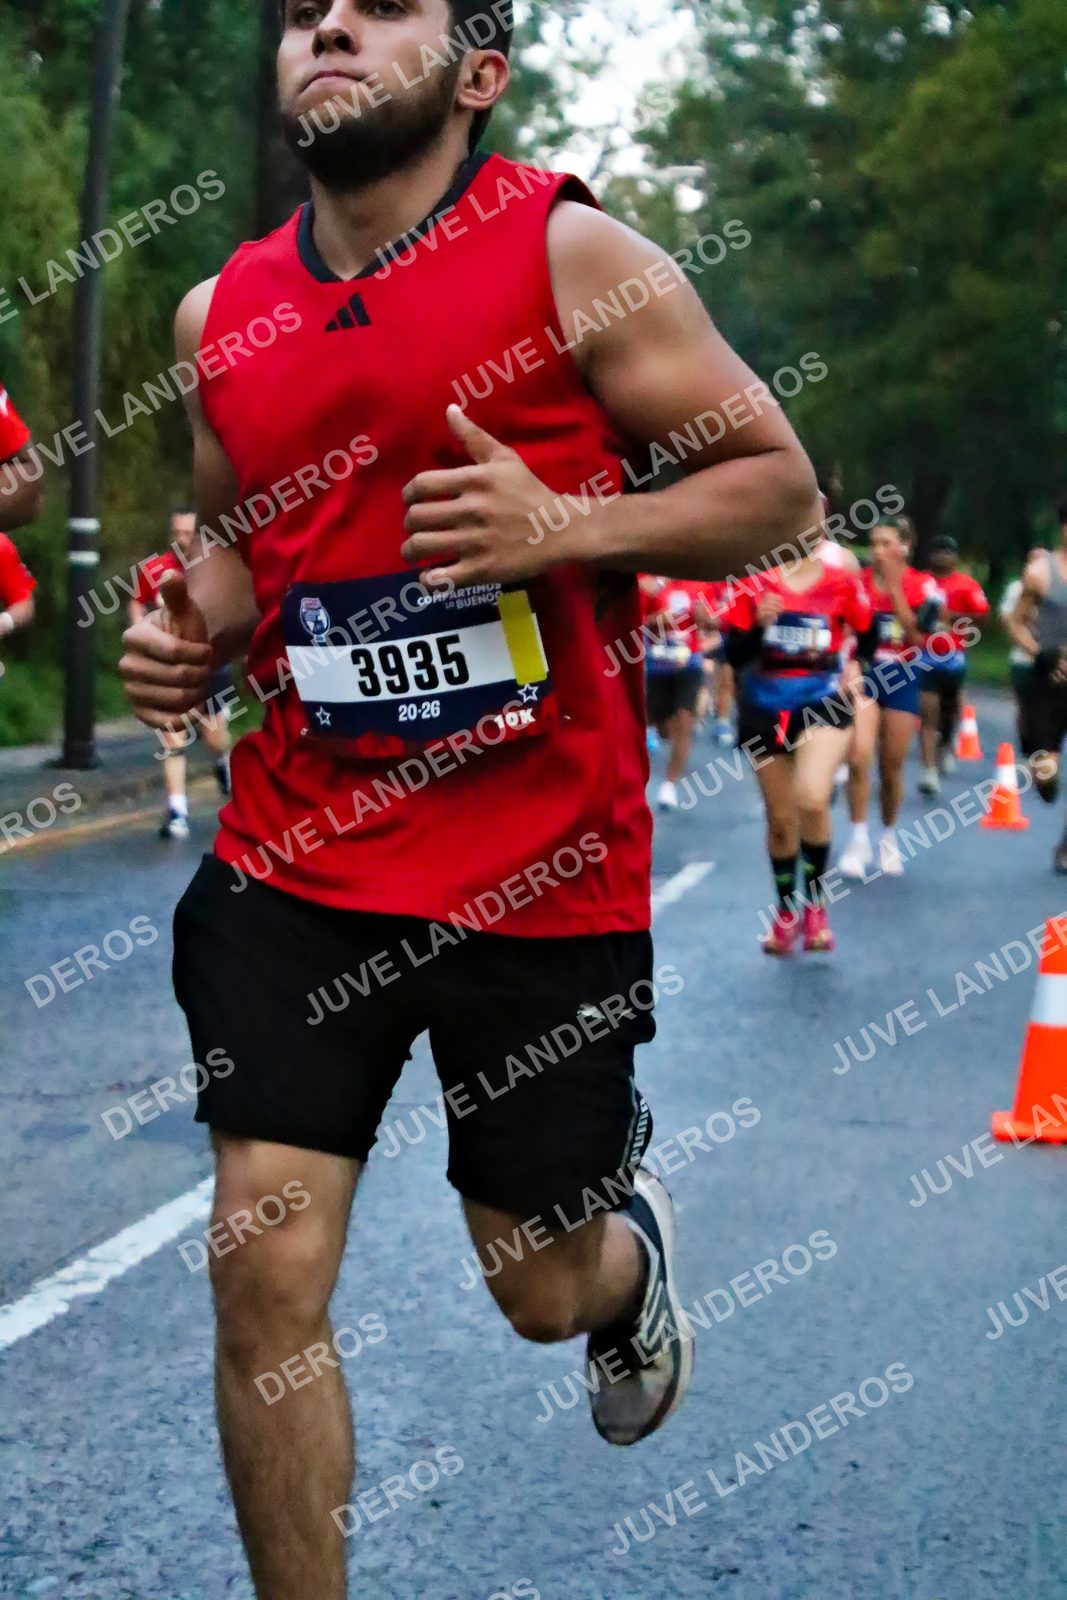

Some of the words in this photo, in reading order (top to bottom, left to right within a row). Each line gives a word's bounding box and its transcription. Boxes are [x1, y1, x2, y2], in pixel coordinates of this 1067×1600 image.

[417, 583, 501, 606] COMPARTIMOS
[351, 634, 469, 697] 3935
[494, 708, 536, 729] 10K
